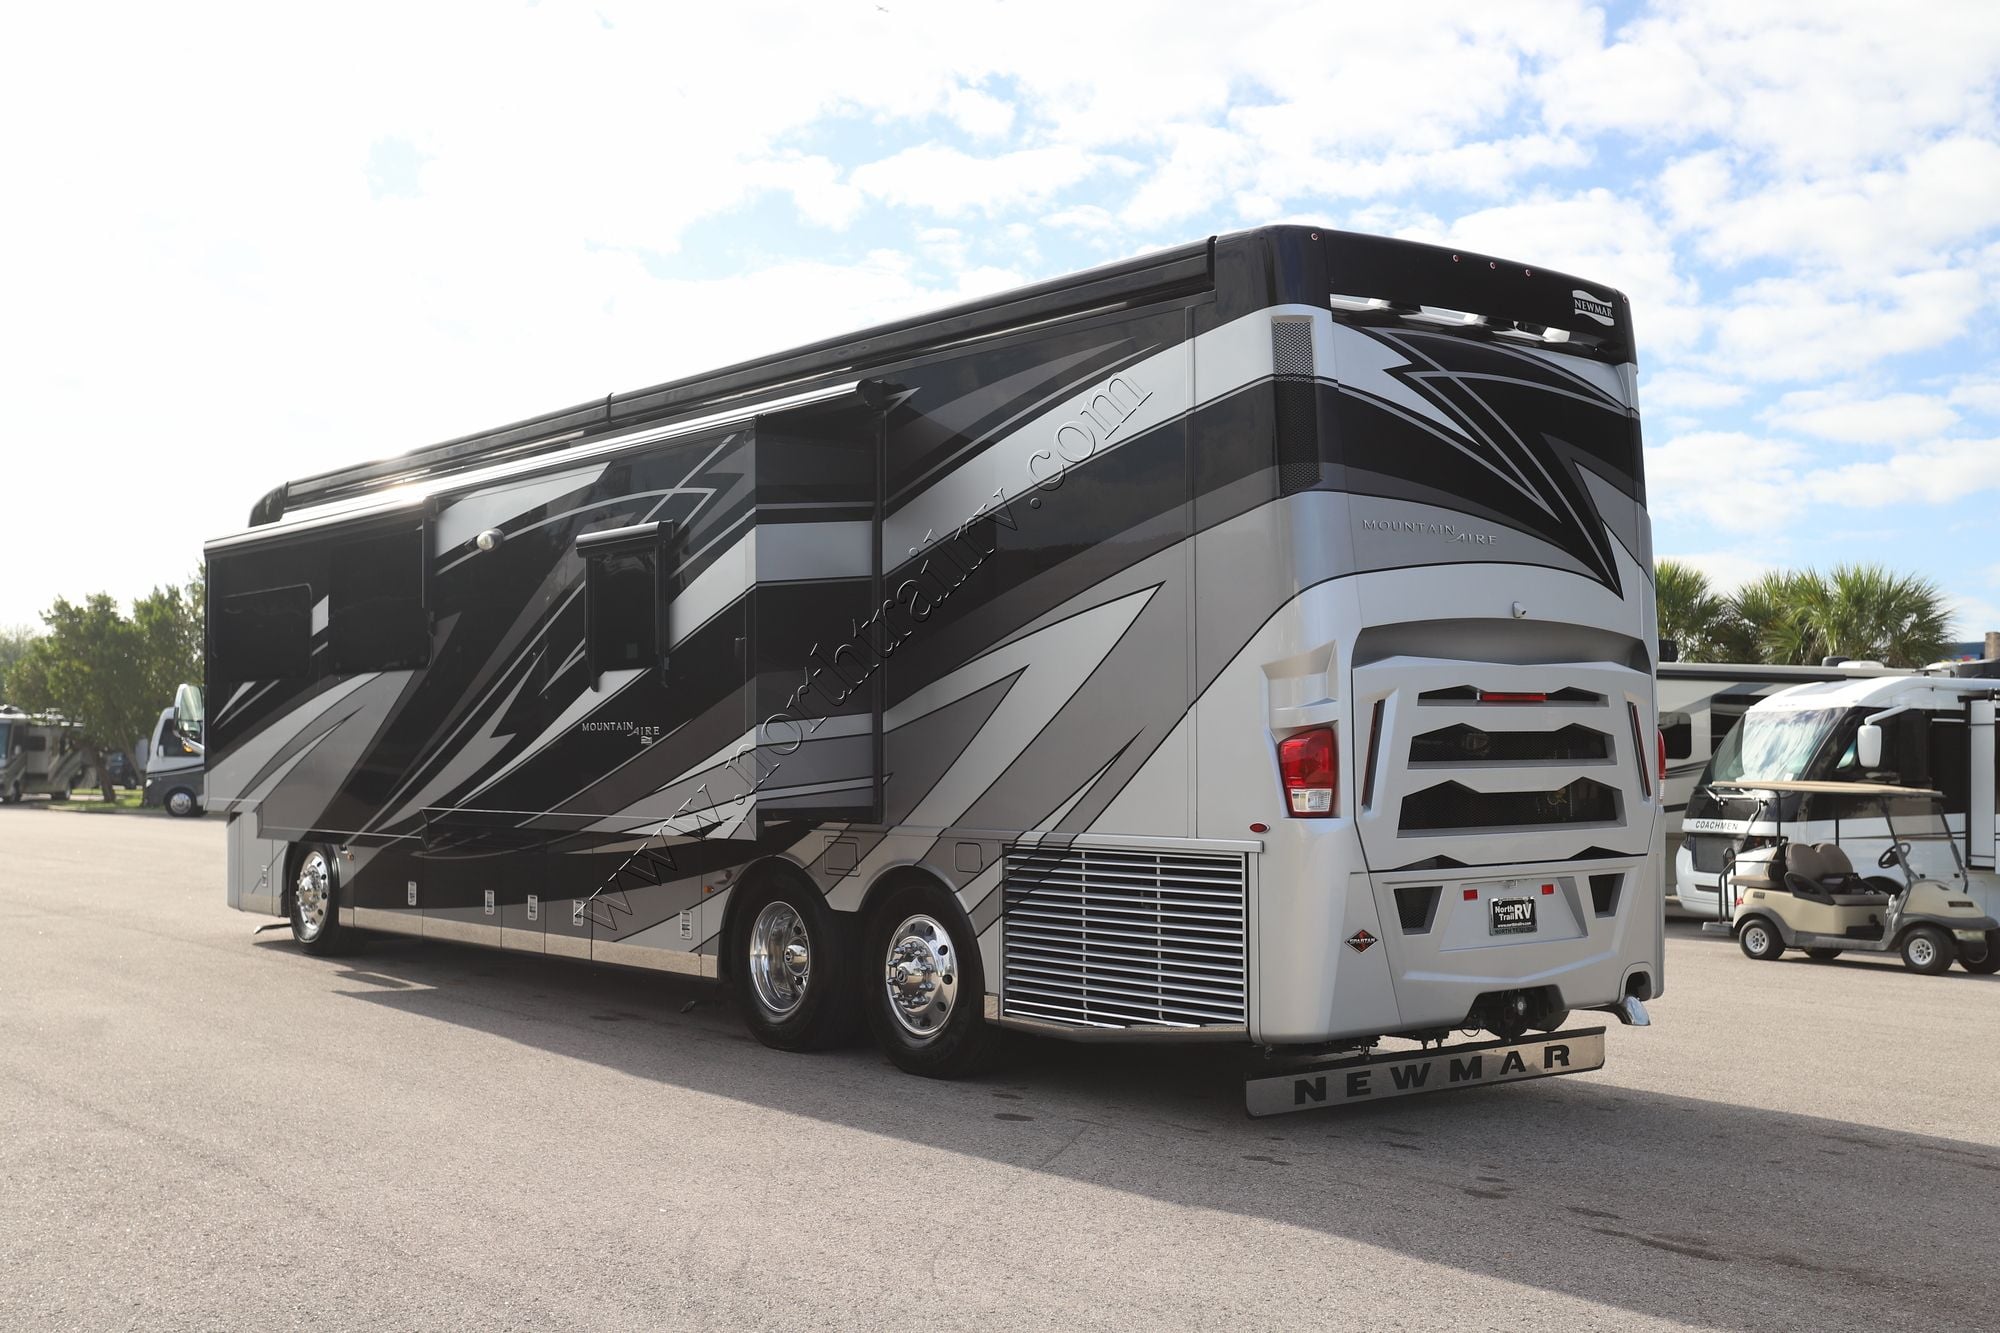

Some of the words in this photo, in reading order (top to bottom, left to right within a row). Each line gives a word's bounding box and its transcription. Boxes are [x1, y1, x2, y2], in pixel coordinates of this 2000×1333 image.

[1574, 299, 1613, 317] NEWMAR
[1362, 519, 1455, 536] MOUNTAIN
[1445, 533, 1497, 545] AIRE
[582, 721, 633, 731] MOUNTAIN
[627, 726, 660, 736] AIRE
[1695, 820, 1739, 830] COACHMEN
[1495, 904, 1514, 913] North
[1514, 903, 1532, 920] RV
[1499, 913, 1514, 921] Trail
[1294, 1044, 1570, 1105] NEWMAR
